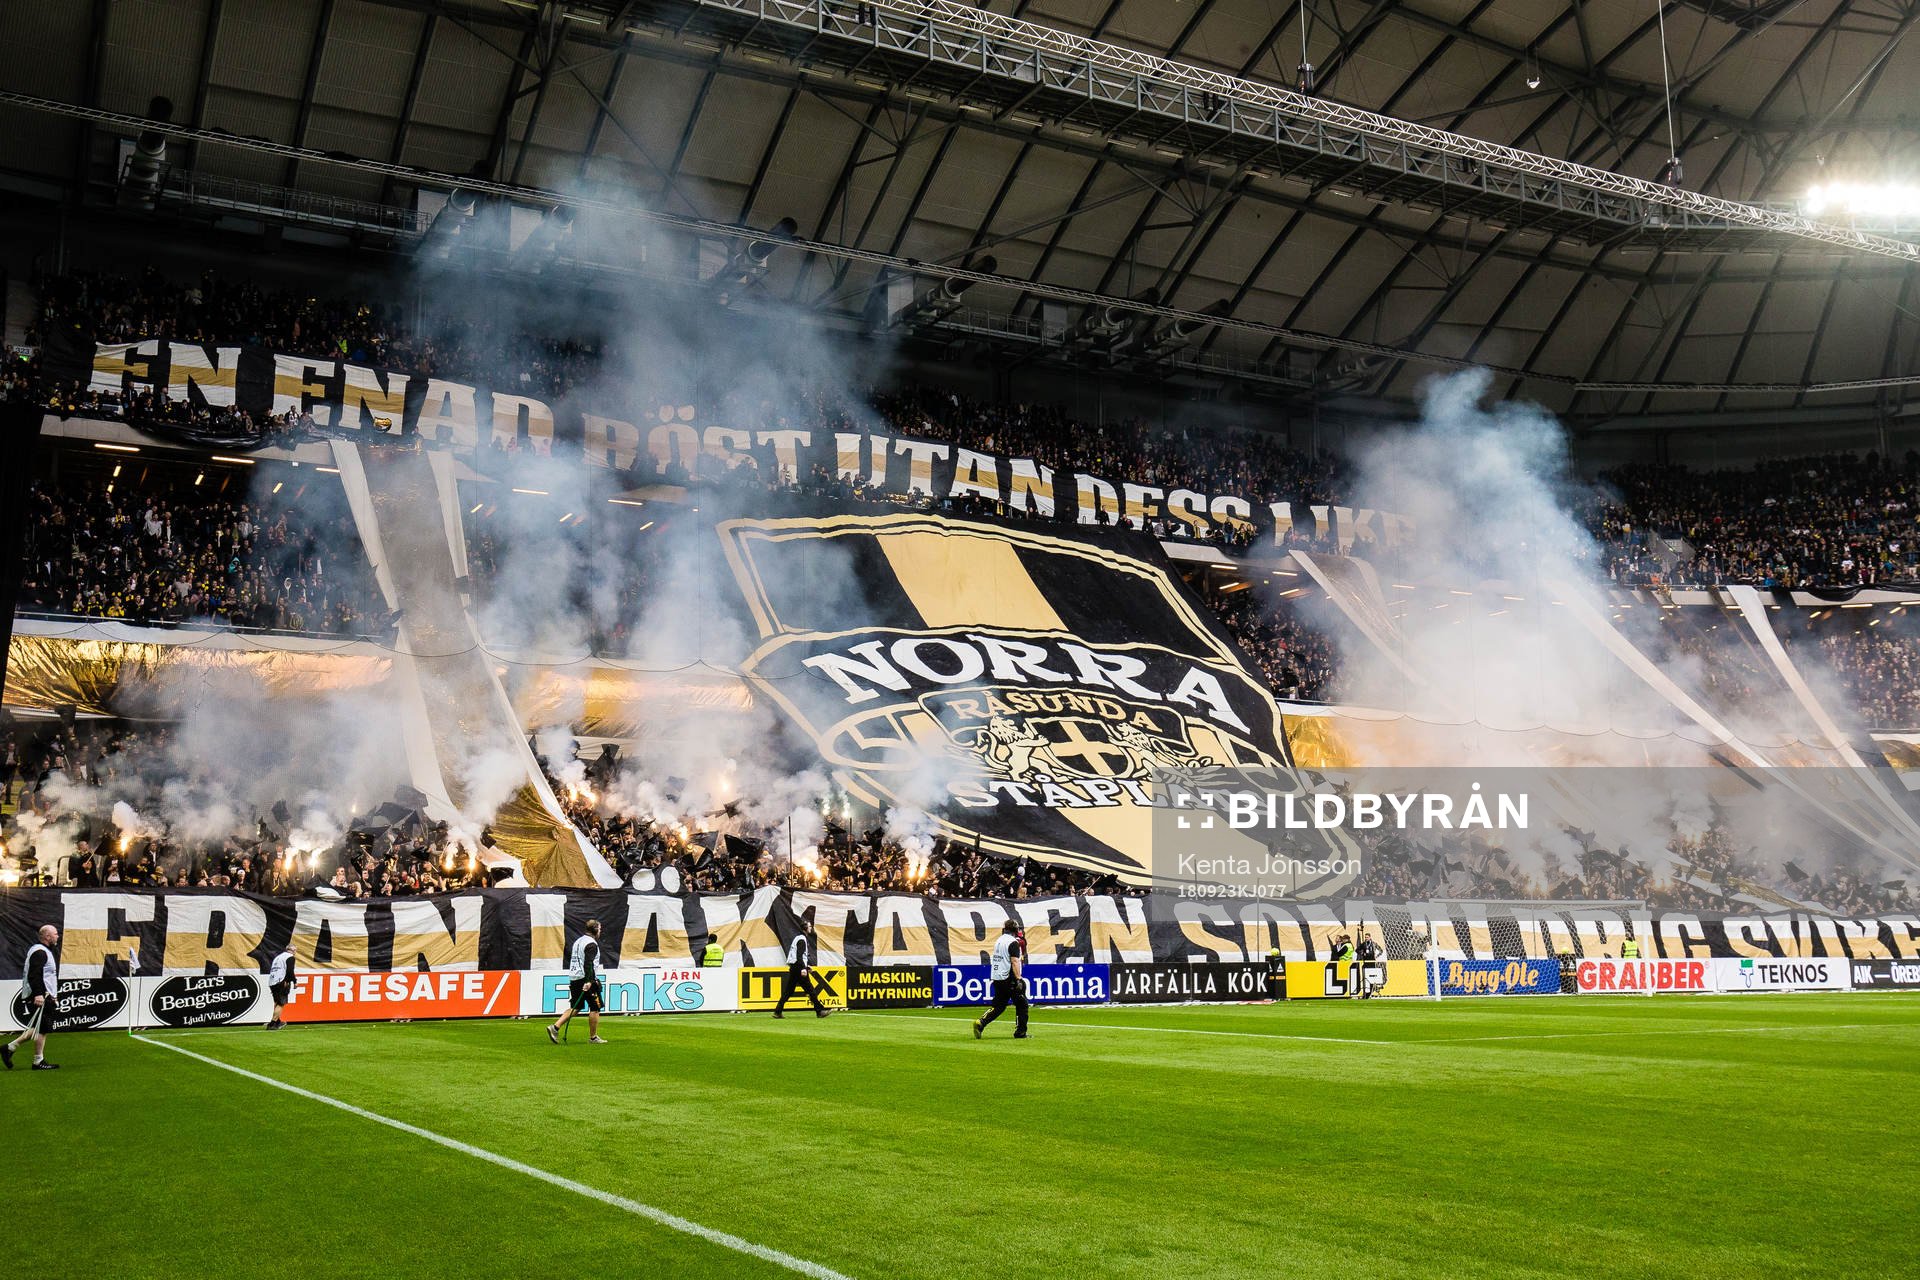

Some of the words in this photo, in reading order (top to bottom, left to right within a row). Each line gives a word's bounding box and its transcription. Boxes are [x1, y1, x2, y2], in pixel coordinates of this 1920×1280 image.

[834, 432, 1056, 518] UTAN
[1074, 473, 1251, 541] DESS
[802, 632, 1252, 735] NORRA
[947, 690, 1163, 734] RÅSUNDA
[662, 968, 702, 981] JÄRN
[859, 972, 921, 984] MASKIN-
[1112, 968, 1217, 995] JÄRFÄLLA
[1228, 967, 1268, 993] KÖK
[1577, 961, 1705, 991] GRABBER
[1758, 964, 1828, 984] TEKNOS
[1853, 965, 1875, 984] AIK
[1890, 961, 1920, 984] ÖREB
[184, 976, 225, 992] Lars
[847, 987, 932, 1000] UTHYRNING
[160, 987, 250, 1012] Bengtsson
[52, 1015, 98, 1030] jud/Video
[183, 1012, 231, 1026] Ljud/Video
